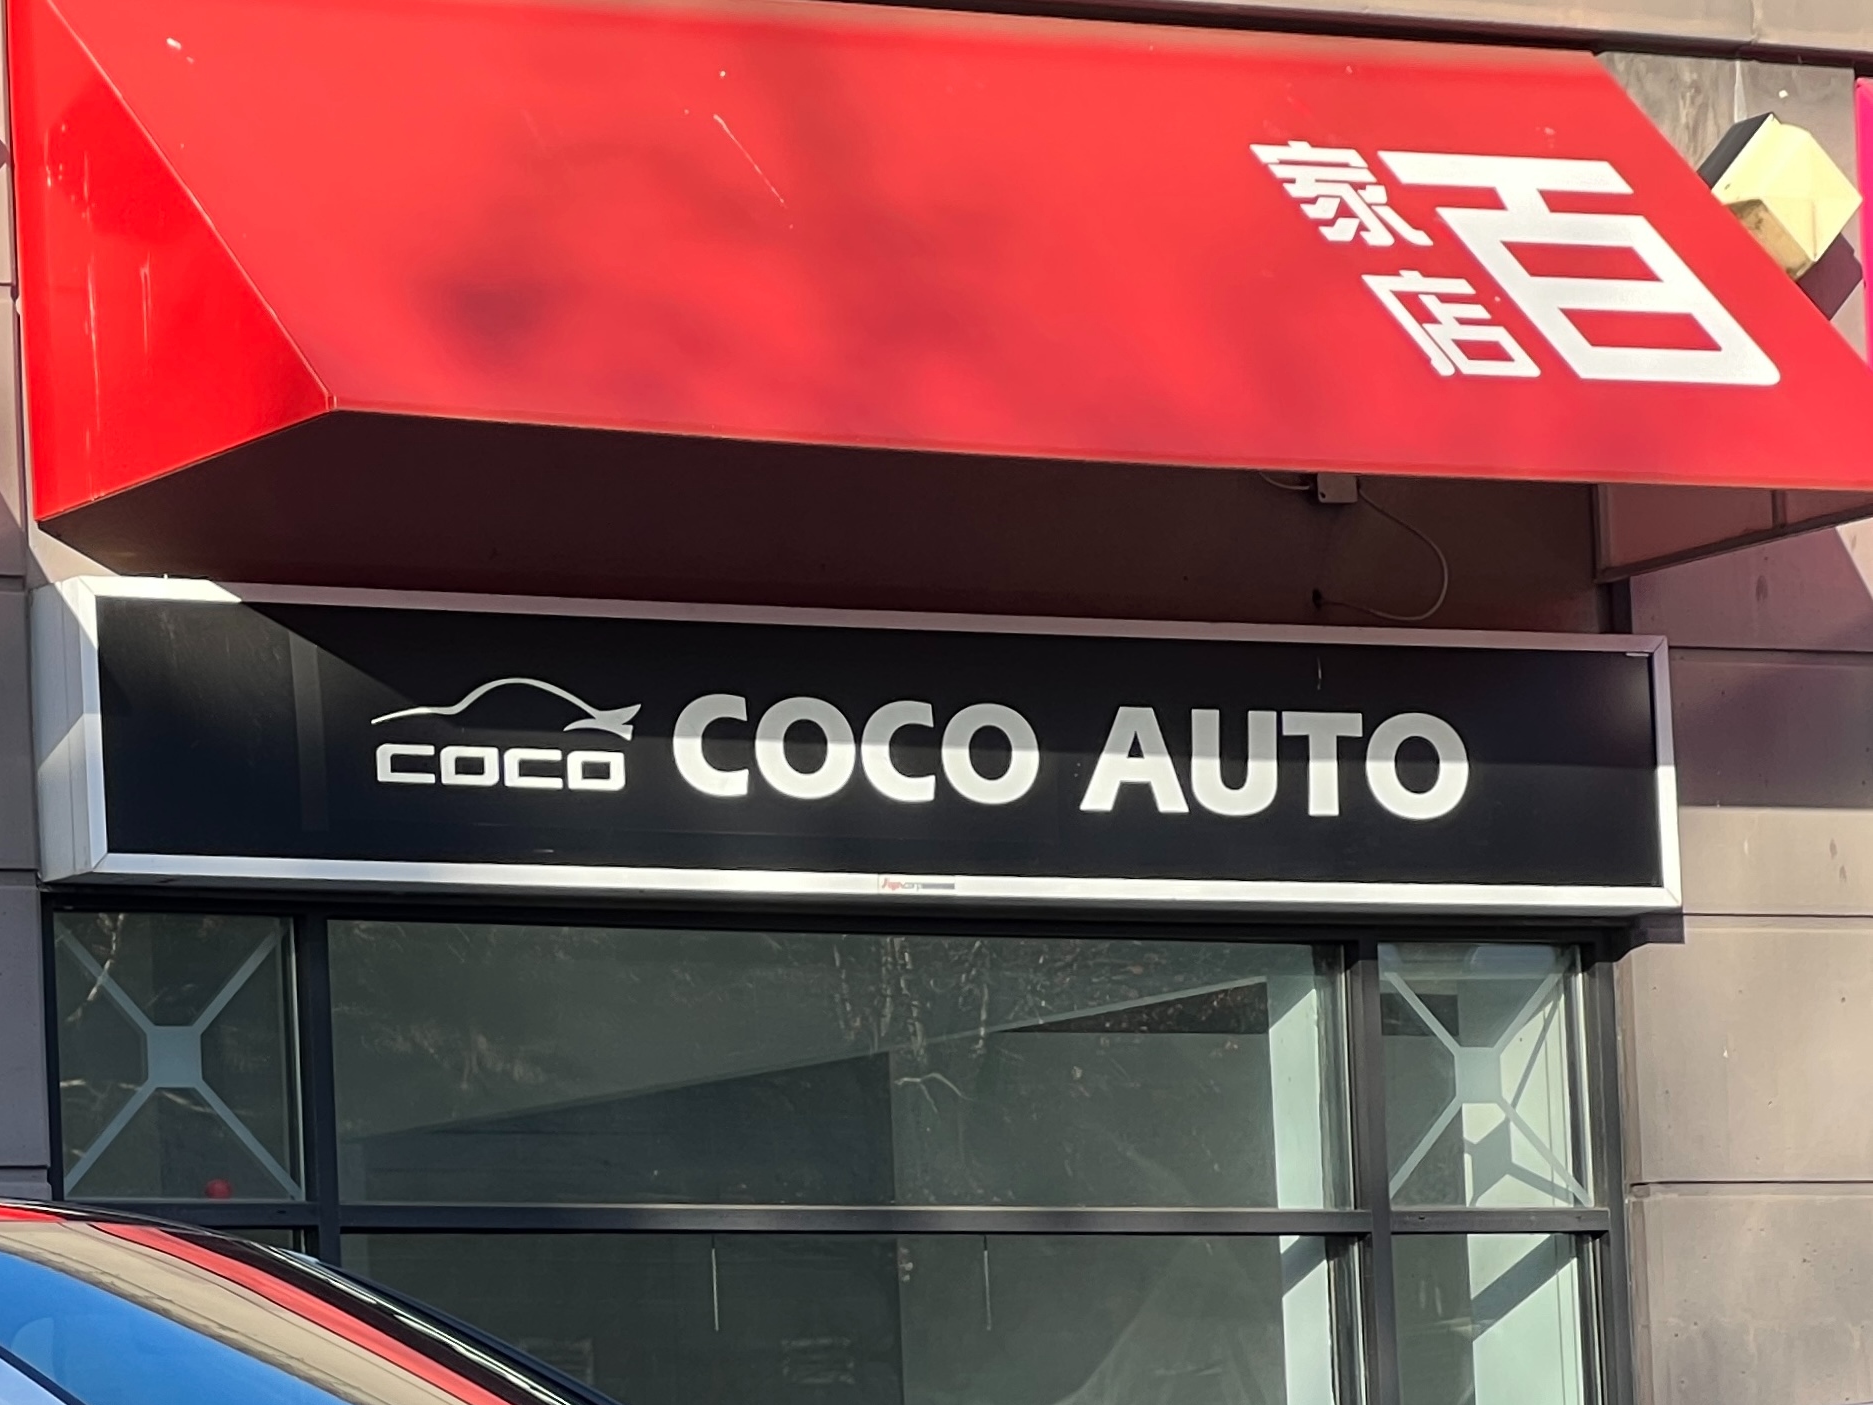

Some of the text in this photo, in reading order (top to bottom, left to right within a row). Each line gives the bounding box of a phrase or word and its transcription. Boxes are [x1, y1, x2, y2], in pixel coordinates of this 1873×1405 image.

[375, 742, 626, 792] COCO
[672, 693, 1470, 822] COCO AUTO
